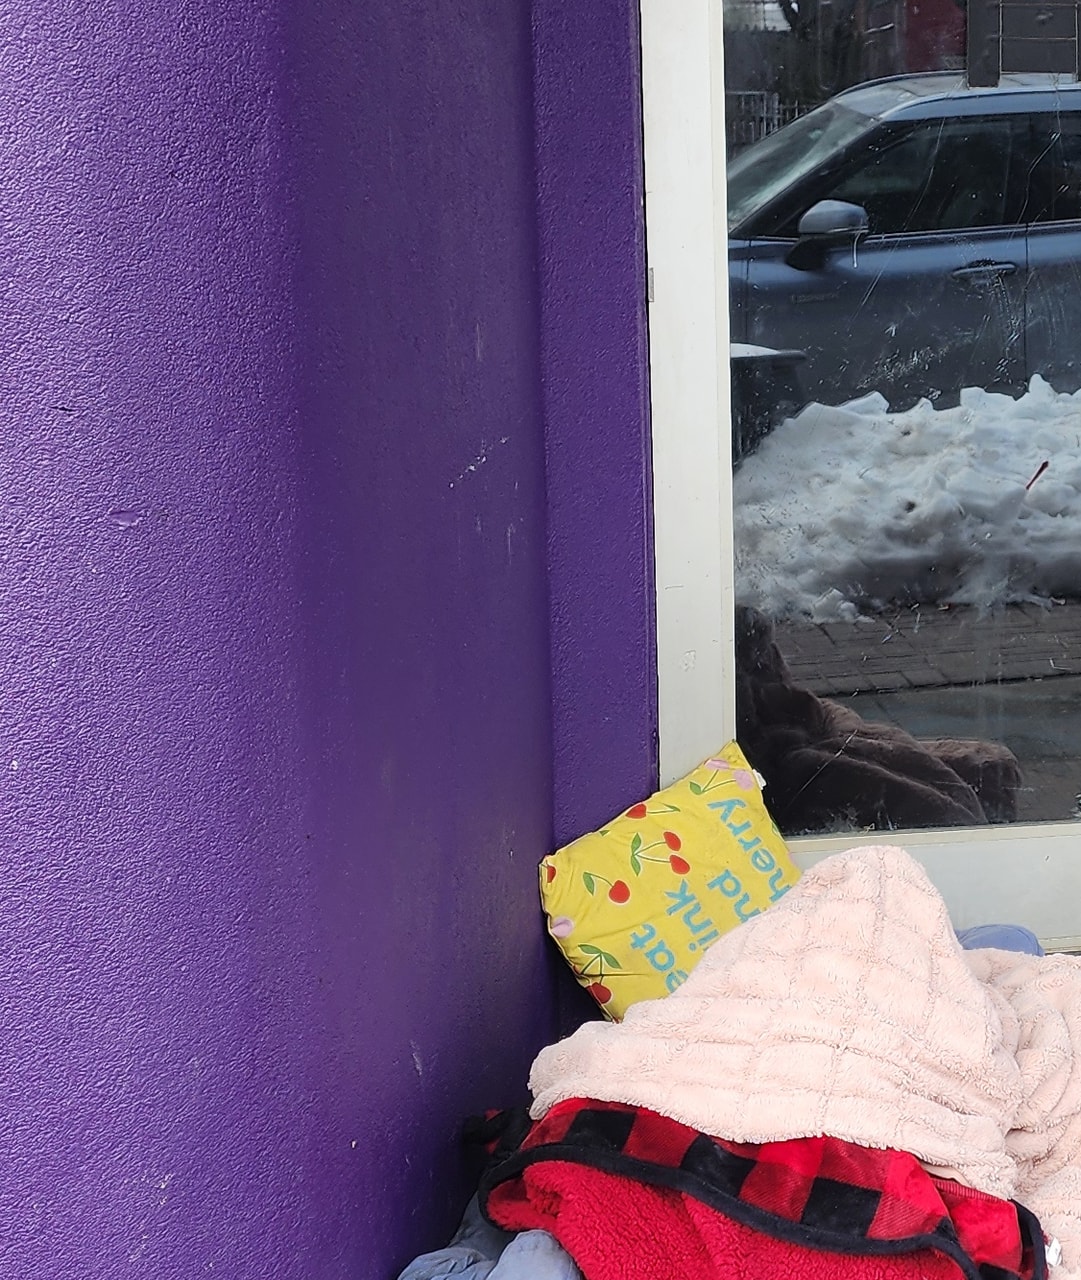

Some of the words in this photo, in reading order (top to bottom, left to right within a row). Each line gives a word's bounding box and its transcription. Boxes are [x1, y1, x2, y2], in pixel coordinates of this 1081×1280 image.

[706, 798, 793, 903] herry
[664, 878, 720, 952] ink
[706, 868, 761, 924] nd
